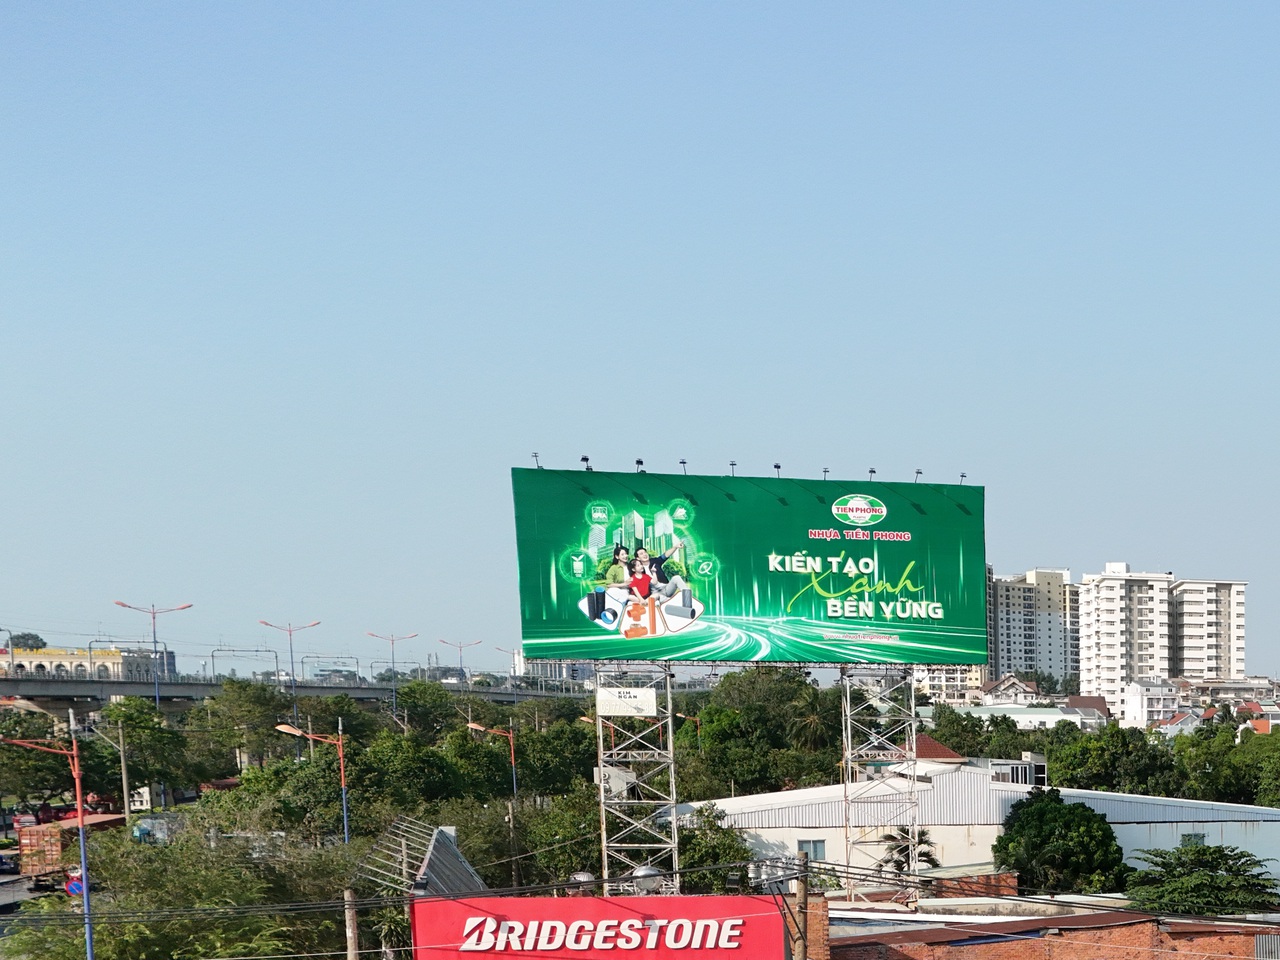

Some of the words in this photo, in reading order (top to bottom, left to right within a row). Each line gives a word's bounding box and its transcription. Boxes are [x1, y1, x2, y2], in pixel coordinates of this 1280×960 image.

[855, 507, 884, 515] PHONG
[808, 529, 841, 541] NHỰA
[873, 531, 912, 541] PHONG
[827, 556, 876, 577] TẠO
[826, 594, 875, 618] BỀN
[879, 598, 944, 619] VỮNG
[458, 916, 745, 952] BRIDGESTONE
